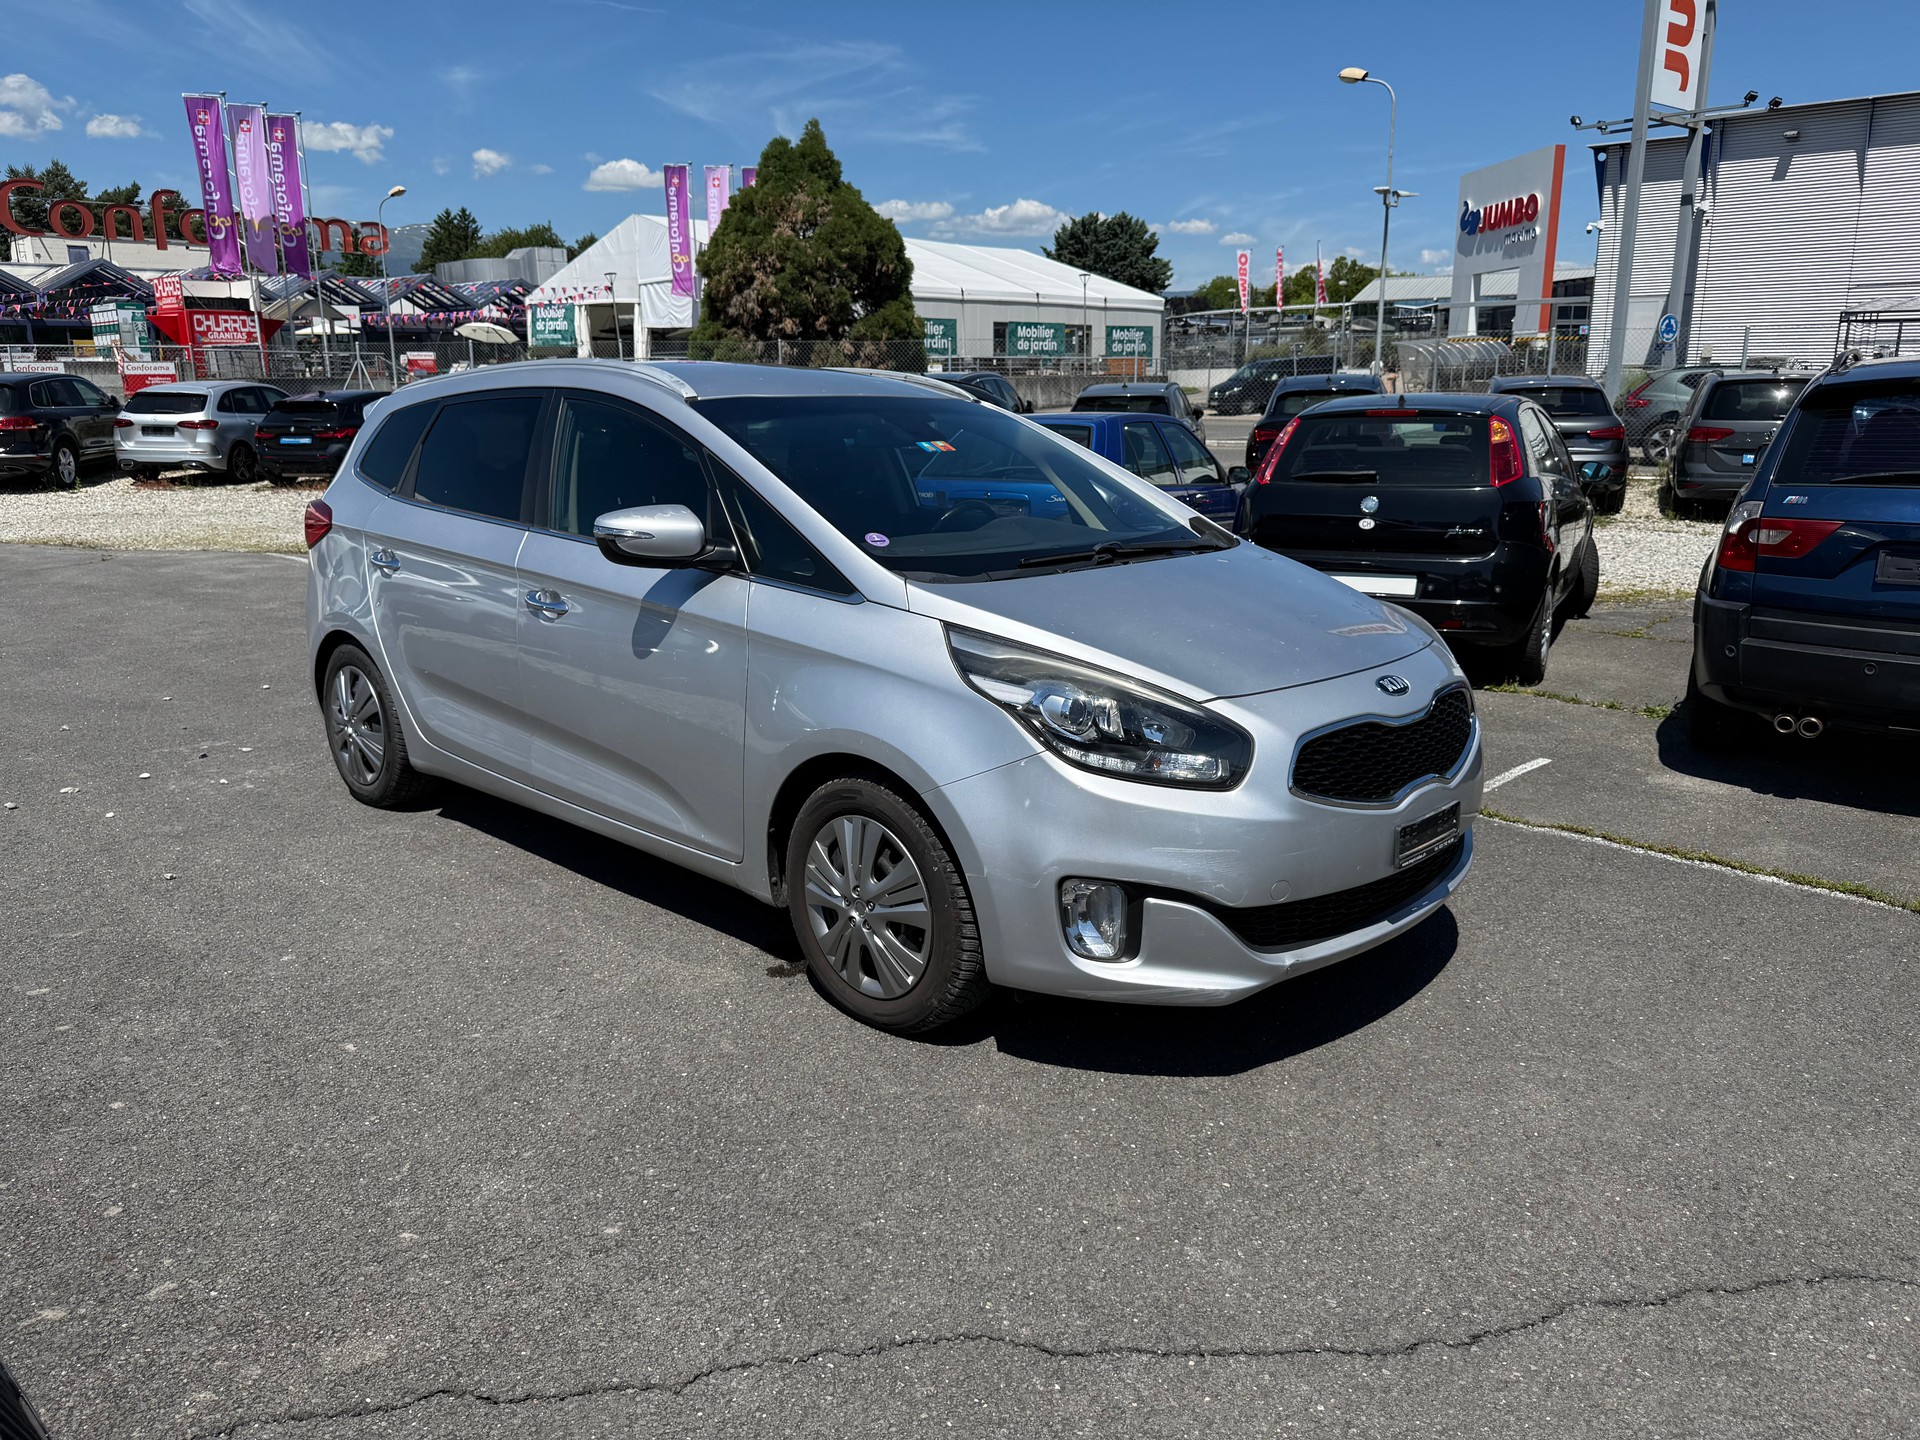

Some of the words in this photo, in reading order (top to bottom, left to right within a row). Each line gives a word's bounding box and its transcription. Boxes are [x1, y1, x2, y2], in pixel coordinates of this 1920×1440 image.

[0, 178, 391, 256] Confoma
[1478, 193, 1539, 234] JUMBO
[1503, 226, 1537, 245] maximo
[153, 276, 181, 297] CHURROS
[193, 314, 258, 332] CHURROS
[536, 318, 546, 331] de
[546, 318, 569, 334] jardin
[207, 331, 248, 340] GRANITAS
[1017, 325, 1055, 339] Mobilier
[1112, 328, 1144, 341] Mobilier
[1017, 338, 1030, 350] de
[1030, 338, 1058, 354] jardin
[1112, 342, 1122, 352] de
[126, 364, 170, 372] Conforama
[1361, 520, 1372, 528] CH
